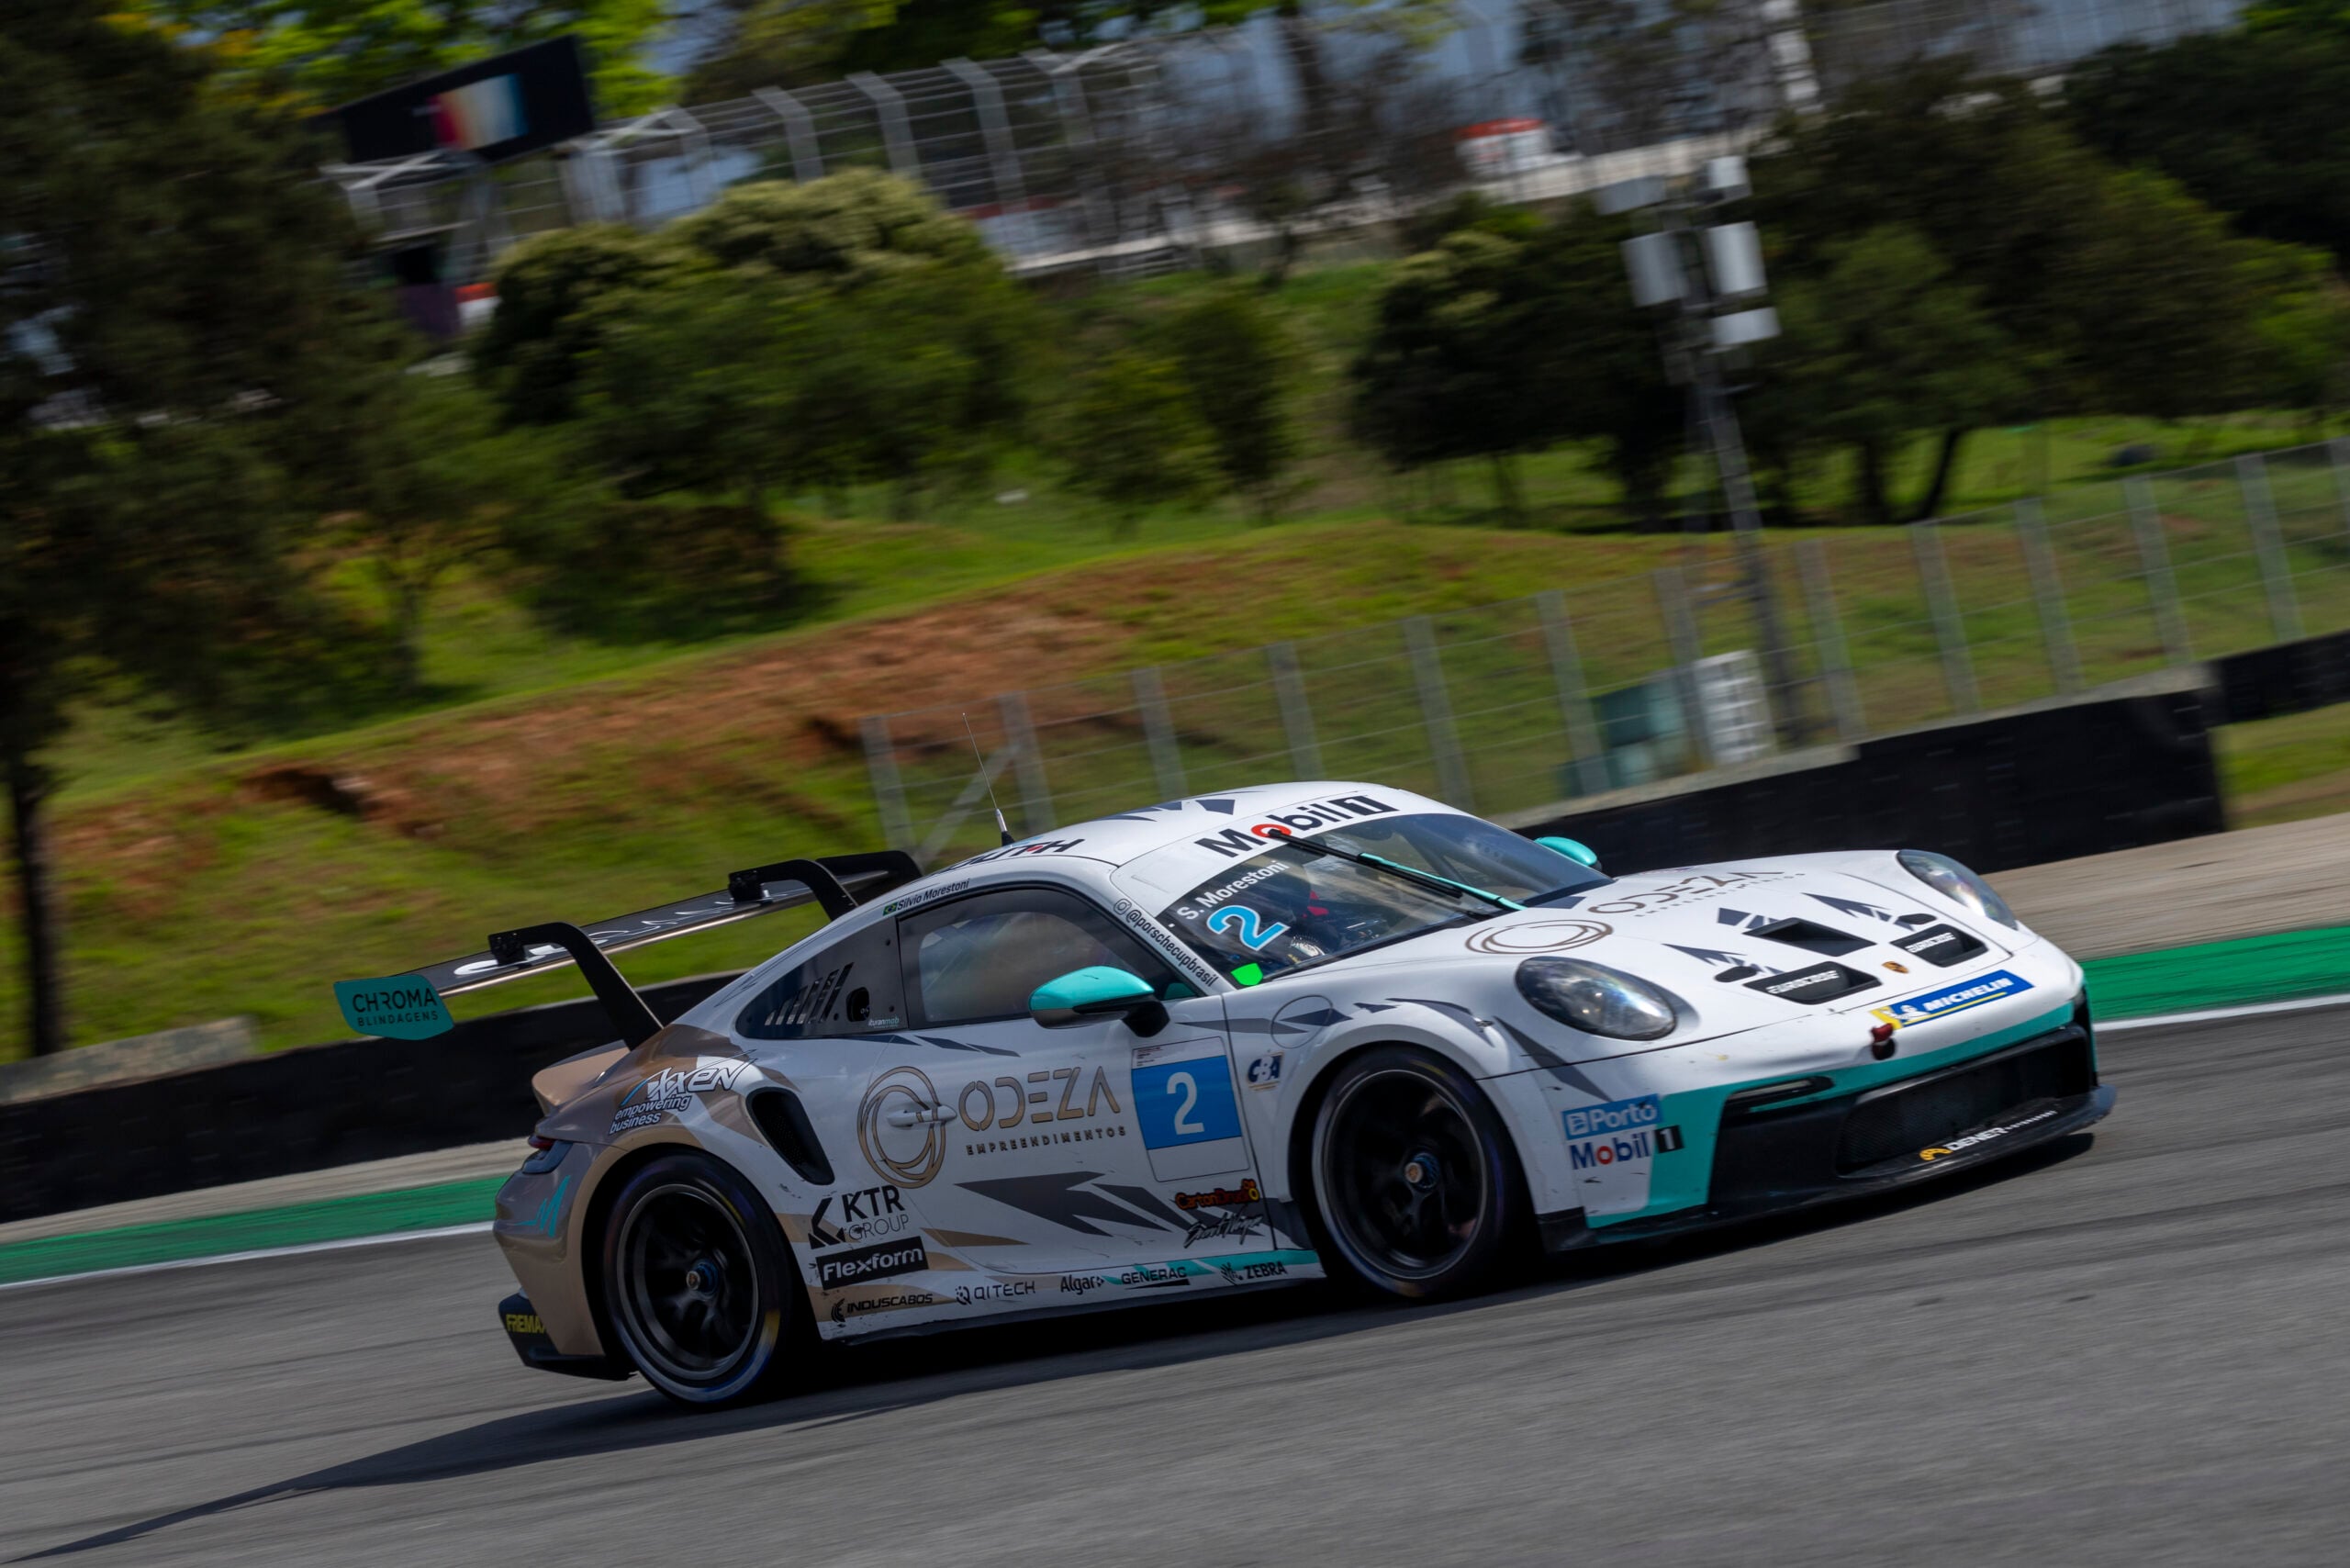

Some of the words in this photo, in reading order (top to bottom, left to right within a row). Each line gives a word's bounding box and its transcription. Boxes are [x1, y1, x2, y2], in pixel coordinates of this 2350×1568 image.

[1194, 803, 1354, 857] Mobil
[897, 895, 923, 911] Silvio
[923, 879, 970, 901] Morestoni
[1176, 906, 1204, 920] S.
[1195, 860, 1290, 907] Morestoni
[1206, 904, 1291, 951] 2
[1125, 909, 1219, 987] @porschecupbrasil
[352, 988, 438, 1014] CHROMA
[1922, 977, 2014, 1012] MICHELIN
[357, 1010, 439, 1027] BLINDAGENS
[614, 1093, 692, 1121] empowering
[958, 1065, 1121, 1131] ODEZA
[1167, 1071, 1205, 1136] 2
[609, 1112, 663, 1136] business
[1589, 1103, 1658, 1131] Porto
[966, 1126, 1126, 1156] EMPREENDIMENTOS
[1569, 1131, 1651, 1170] Mobil
[1942, 1127, 2009, 1151] DENER
[842, 1184, 905, 1223] KTR
[848, 1214, 910, 1240] GROUP
[822, 1248, 924, 1282] Flexform
[1121, 1266, 1188, 1285] GENERAC
[1244, 1260, 1288, 1280] ZEBRA
[1060, 1274, 1095, 1295] Algar
[846, 1294, 934, 1314] INDUSCABOS
[505, 1313, 545, 1335] FREMA
